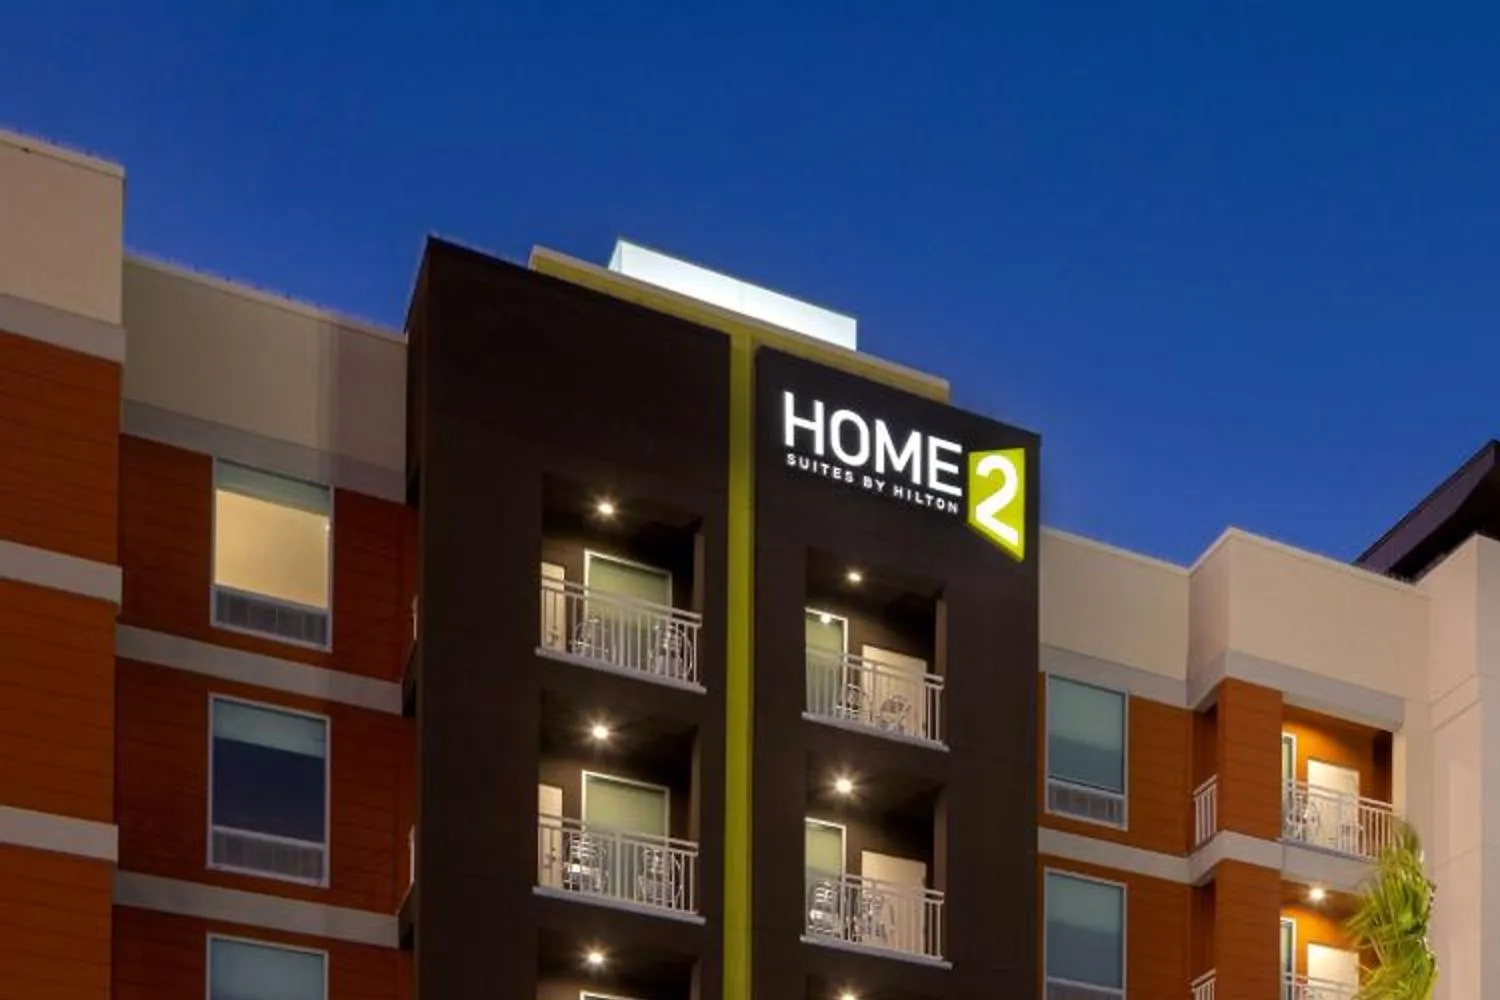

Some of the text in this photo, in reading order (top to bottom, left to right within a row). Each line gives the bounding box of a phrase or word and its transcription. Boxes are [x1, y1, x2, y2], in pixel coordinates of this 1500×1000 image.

[783, 390, 1020, 546] HOME 2
[786, 453, 959, 514] SUITES BY HILTON
